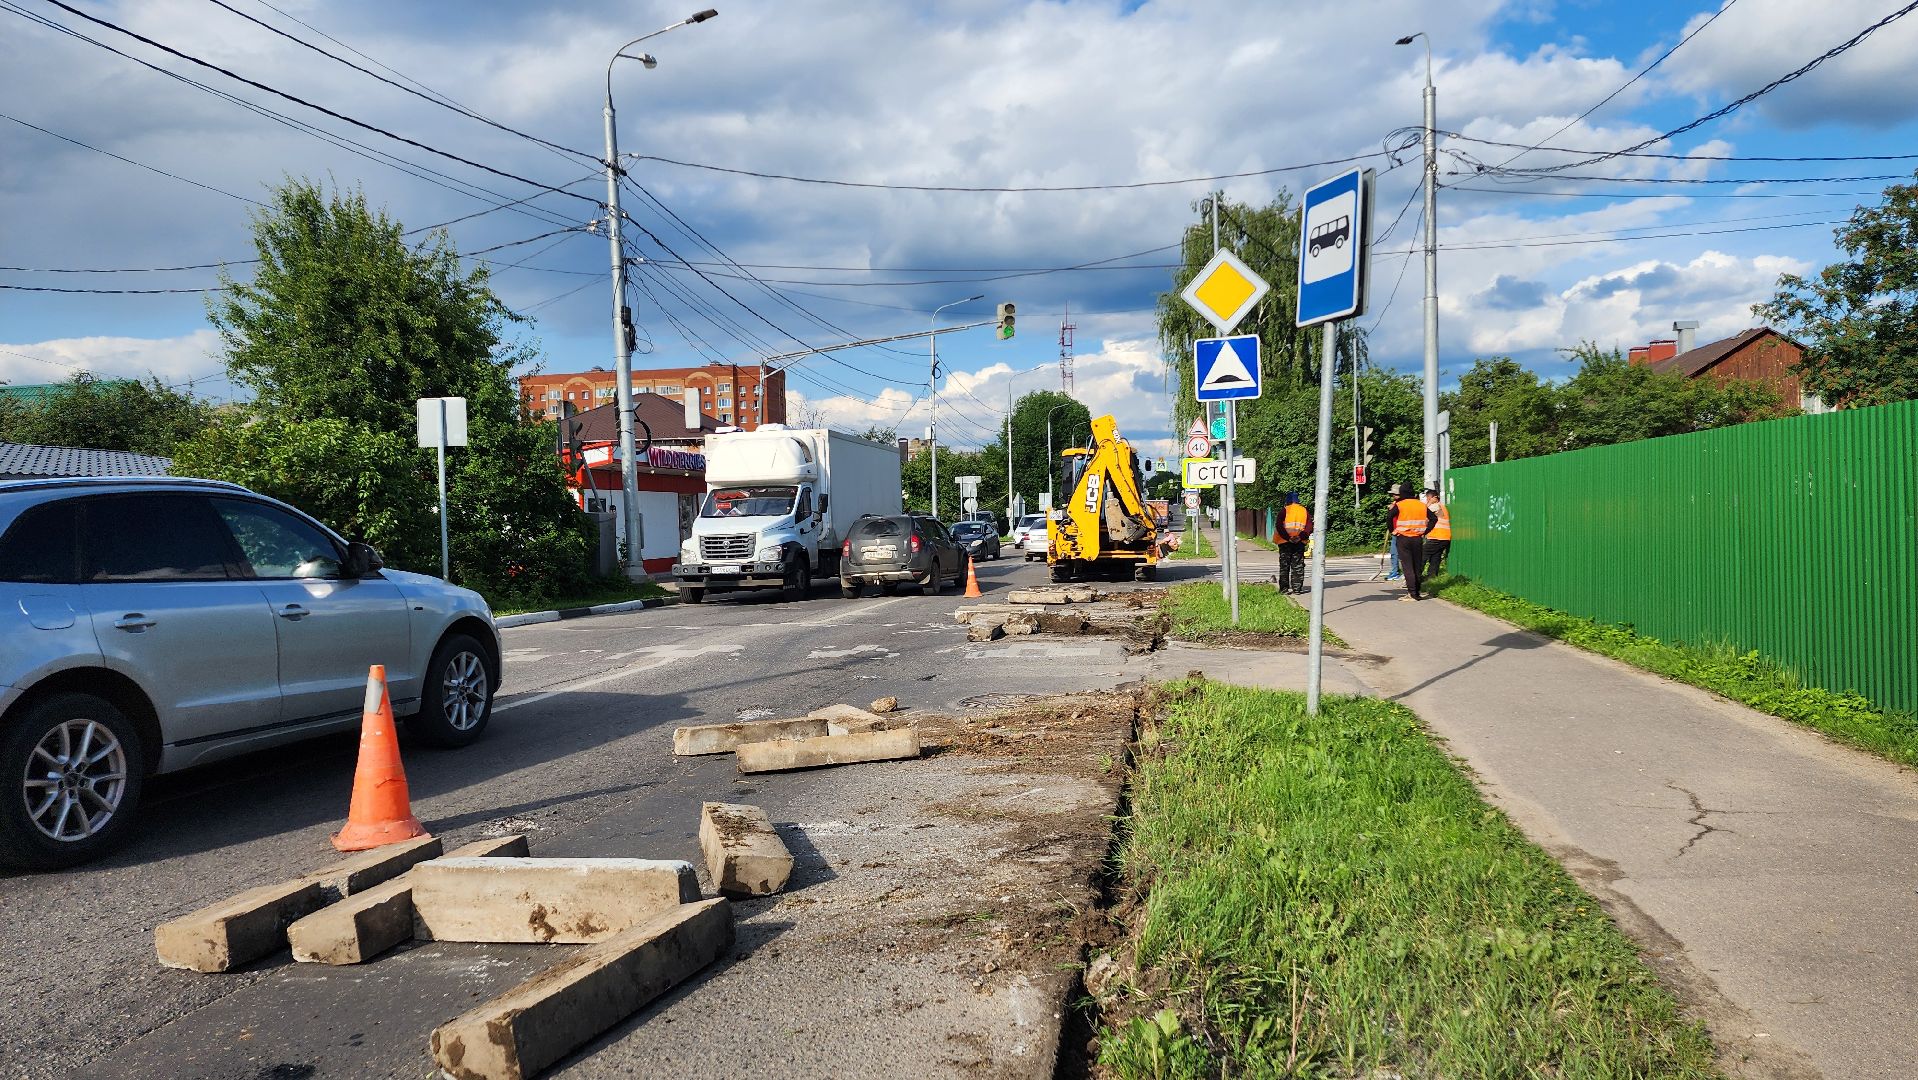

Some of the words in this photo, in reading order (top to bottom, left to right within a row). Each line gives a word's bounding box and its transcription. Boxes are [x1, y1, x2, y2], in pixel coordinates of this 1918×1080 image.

[1191, 443, 1205, 452] 40
[647, 446, 706, 472] WILDBERRIES
[1198, 464, 1245, 481] СТОП
[1085, 474, 1100, 513] JCB
